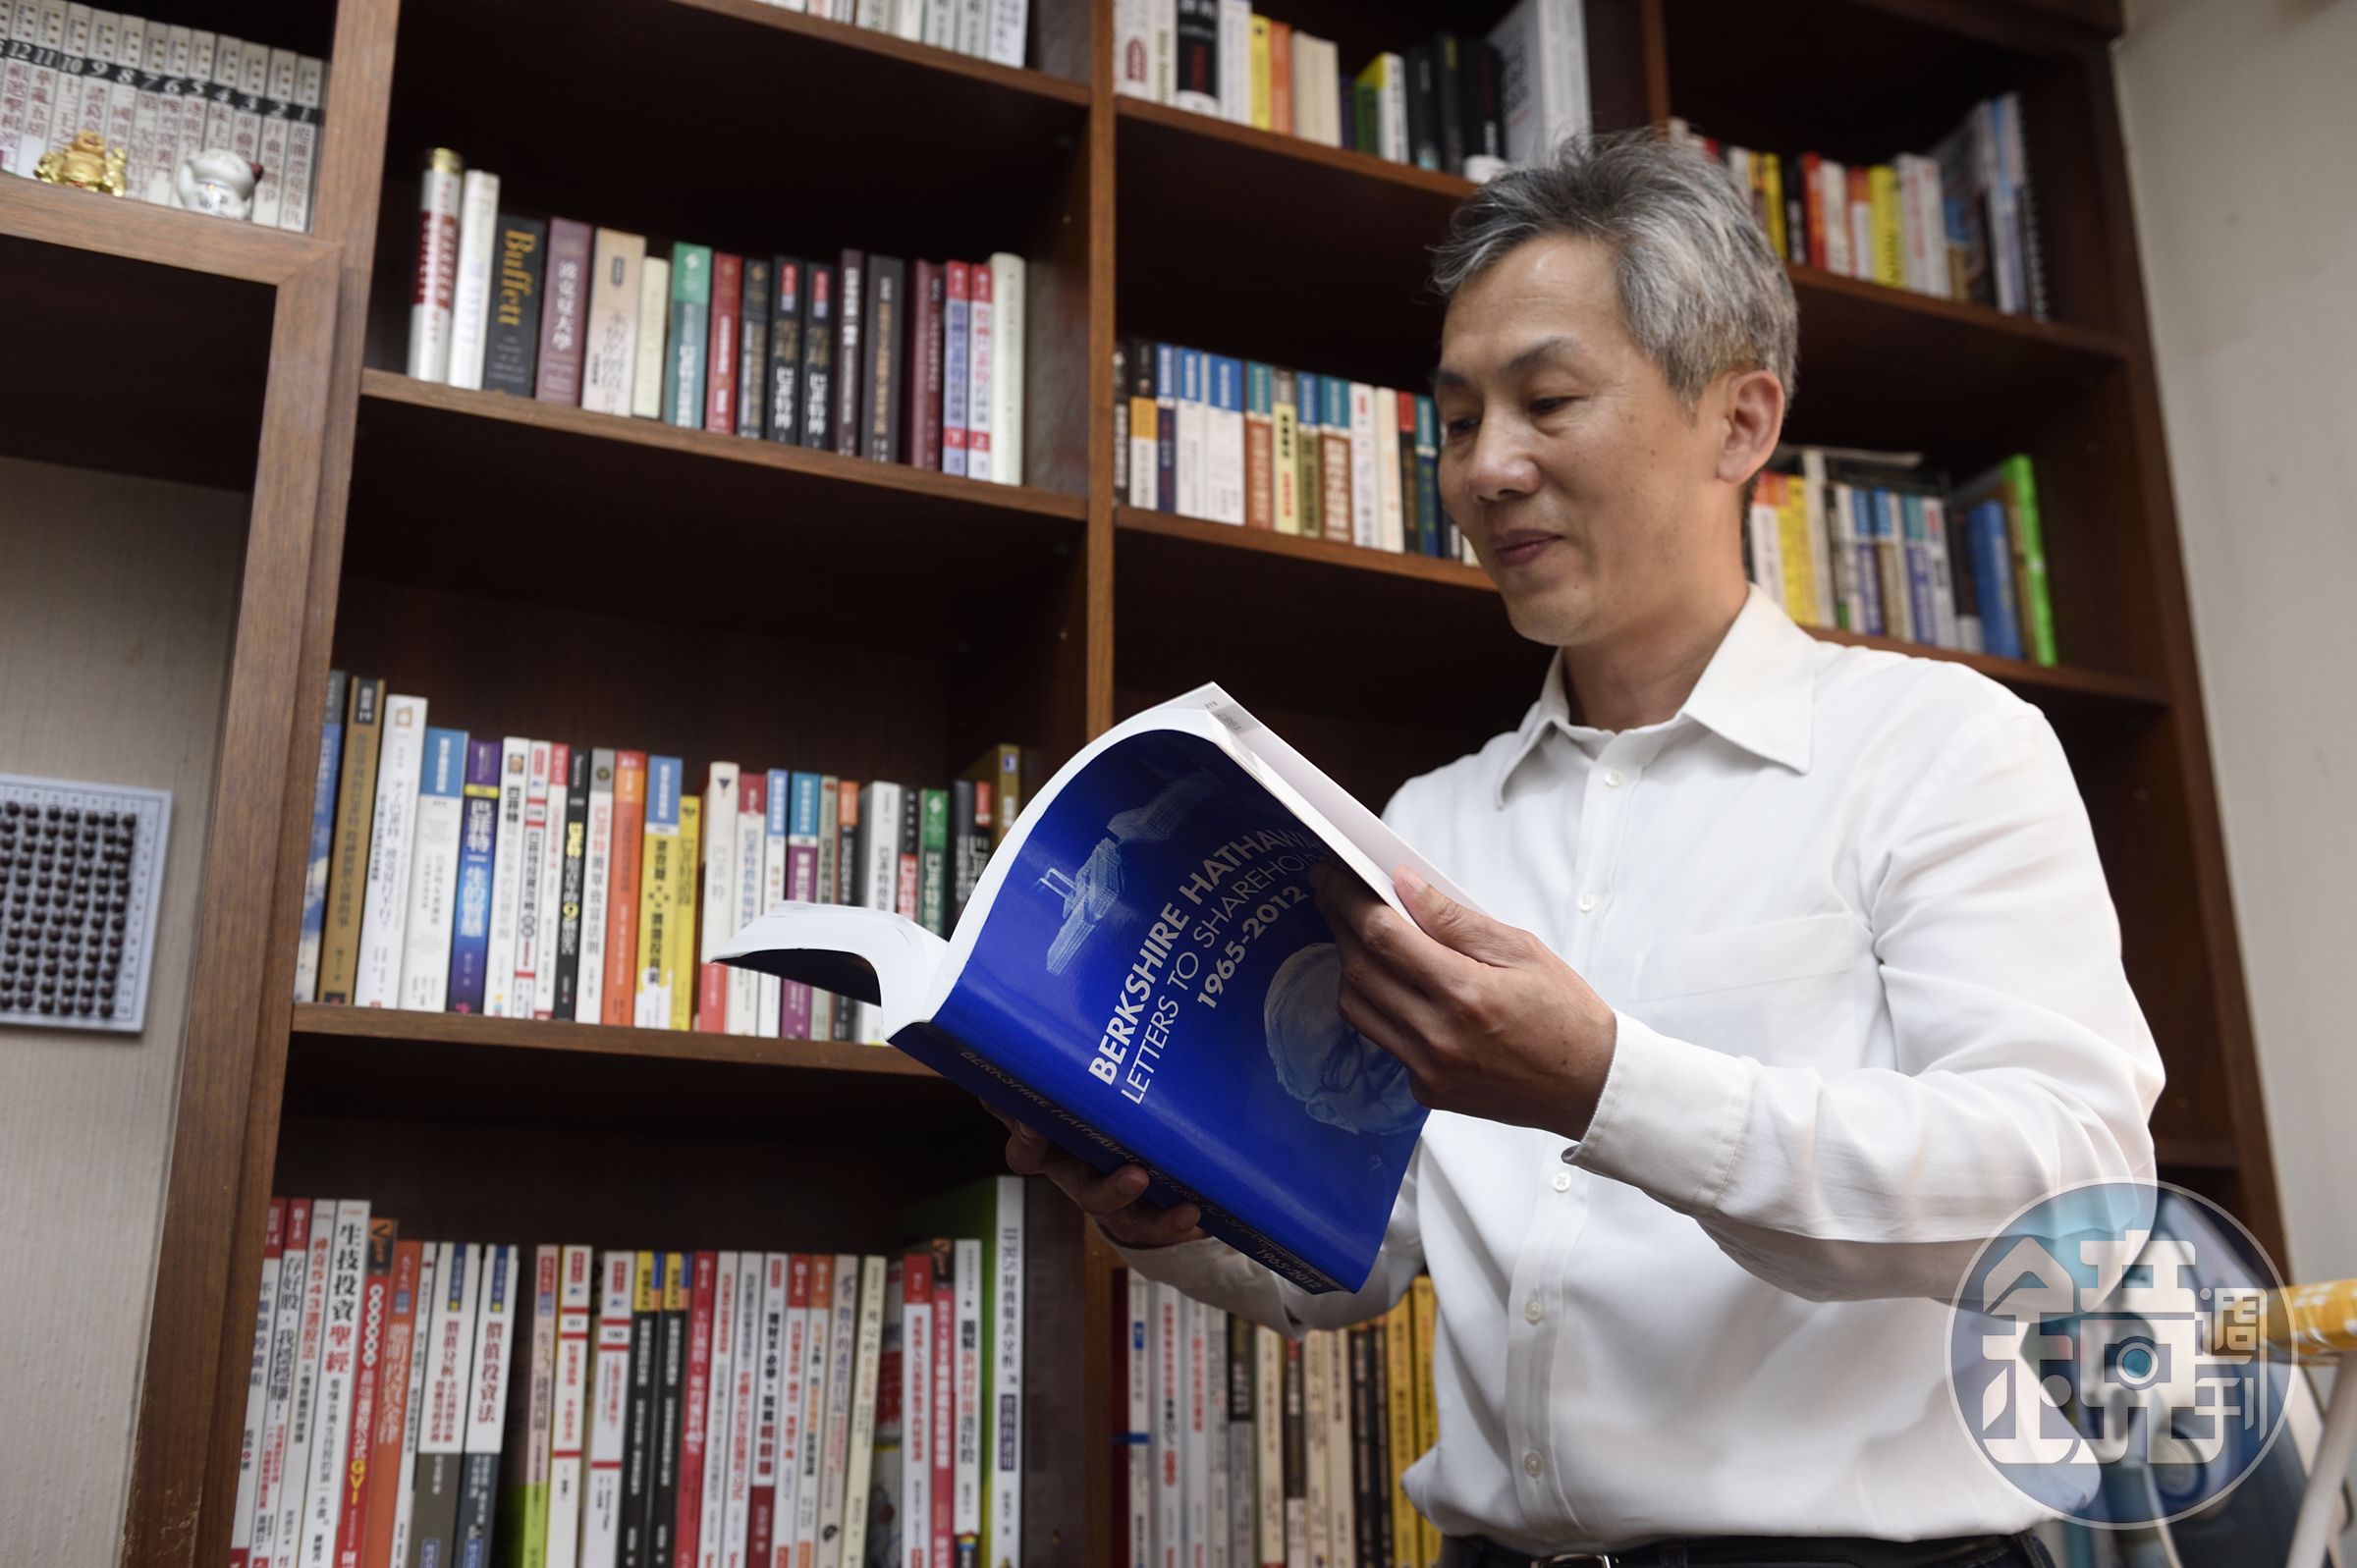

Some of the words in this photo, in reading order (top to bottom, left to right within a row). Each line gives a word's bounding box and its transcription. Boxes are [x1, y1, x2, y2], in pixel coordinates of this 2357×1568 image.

[498, 229, 537, 327] Buffett
[1088, 902, 1190, 1085] BERKSHIRE
[1197, 886, 1309, 1008] 1965-2012
[959, 1050, 1048, 1108] BERKSHIRE
[1121, 995, 1178, 1105] LETTERS
[1167, 951, 1199, 991] TO
[324, 1222, 361, 1375] 生技投資聖經
[441, 1320, 460, 1378] 價值分析
[477, 1322, 504, 1424] 價值投資法
